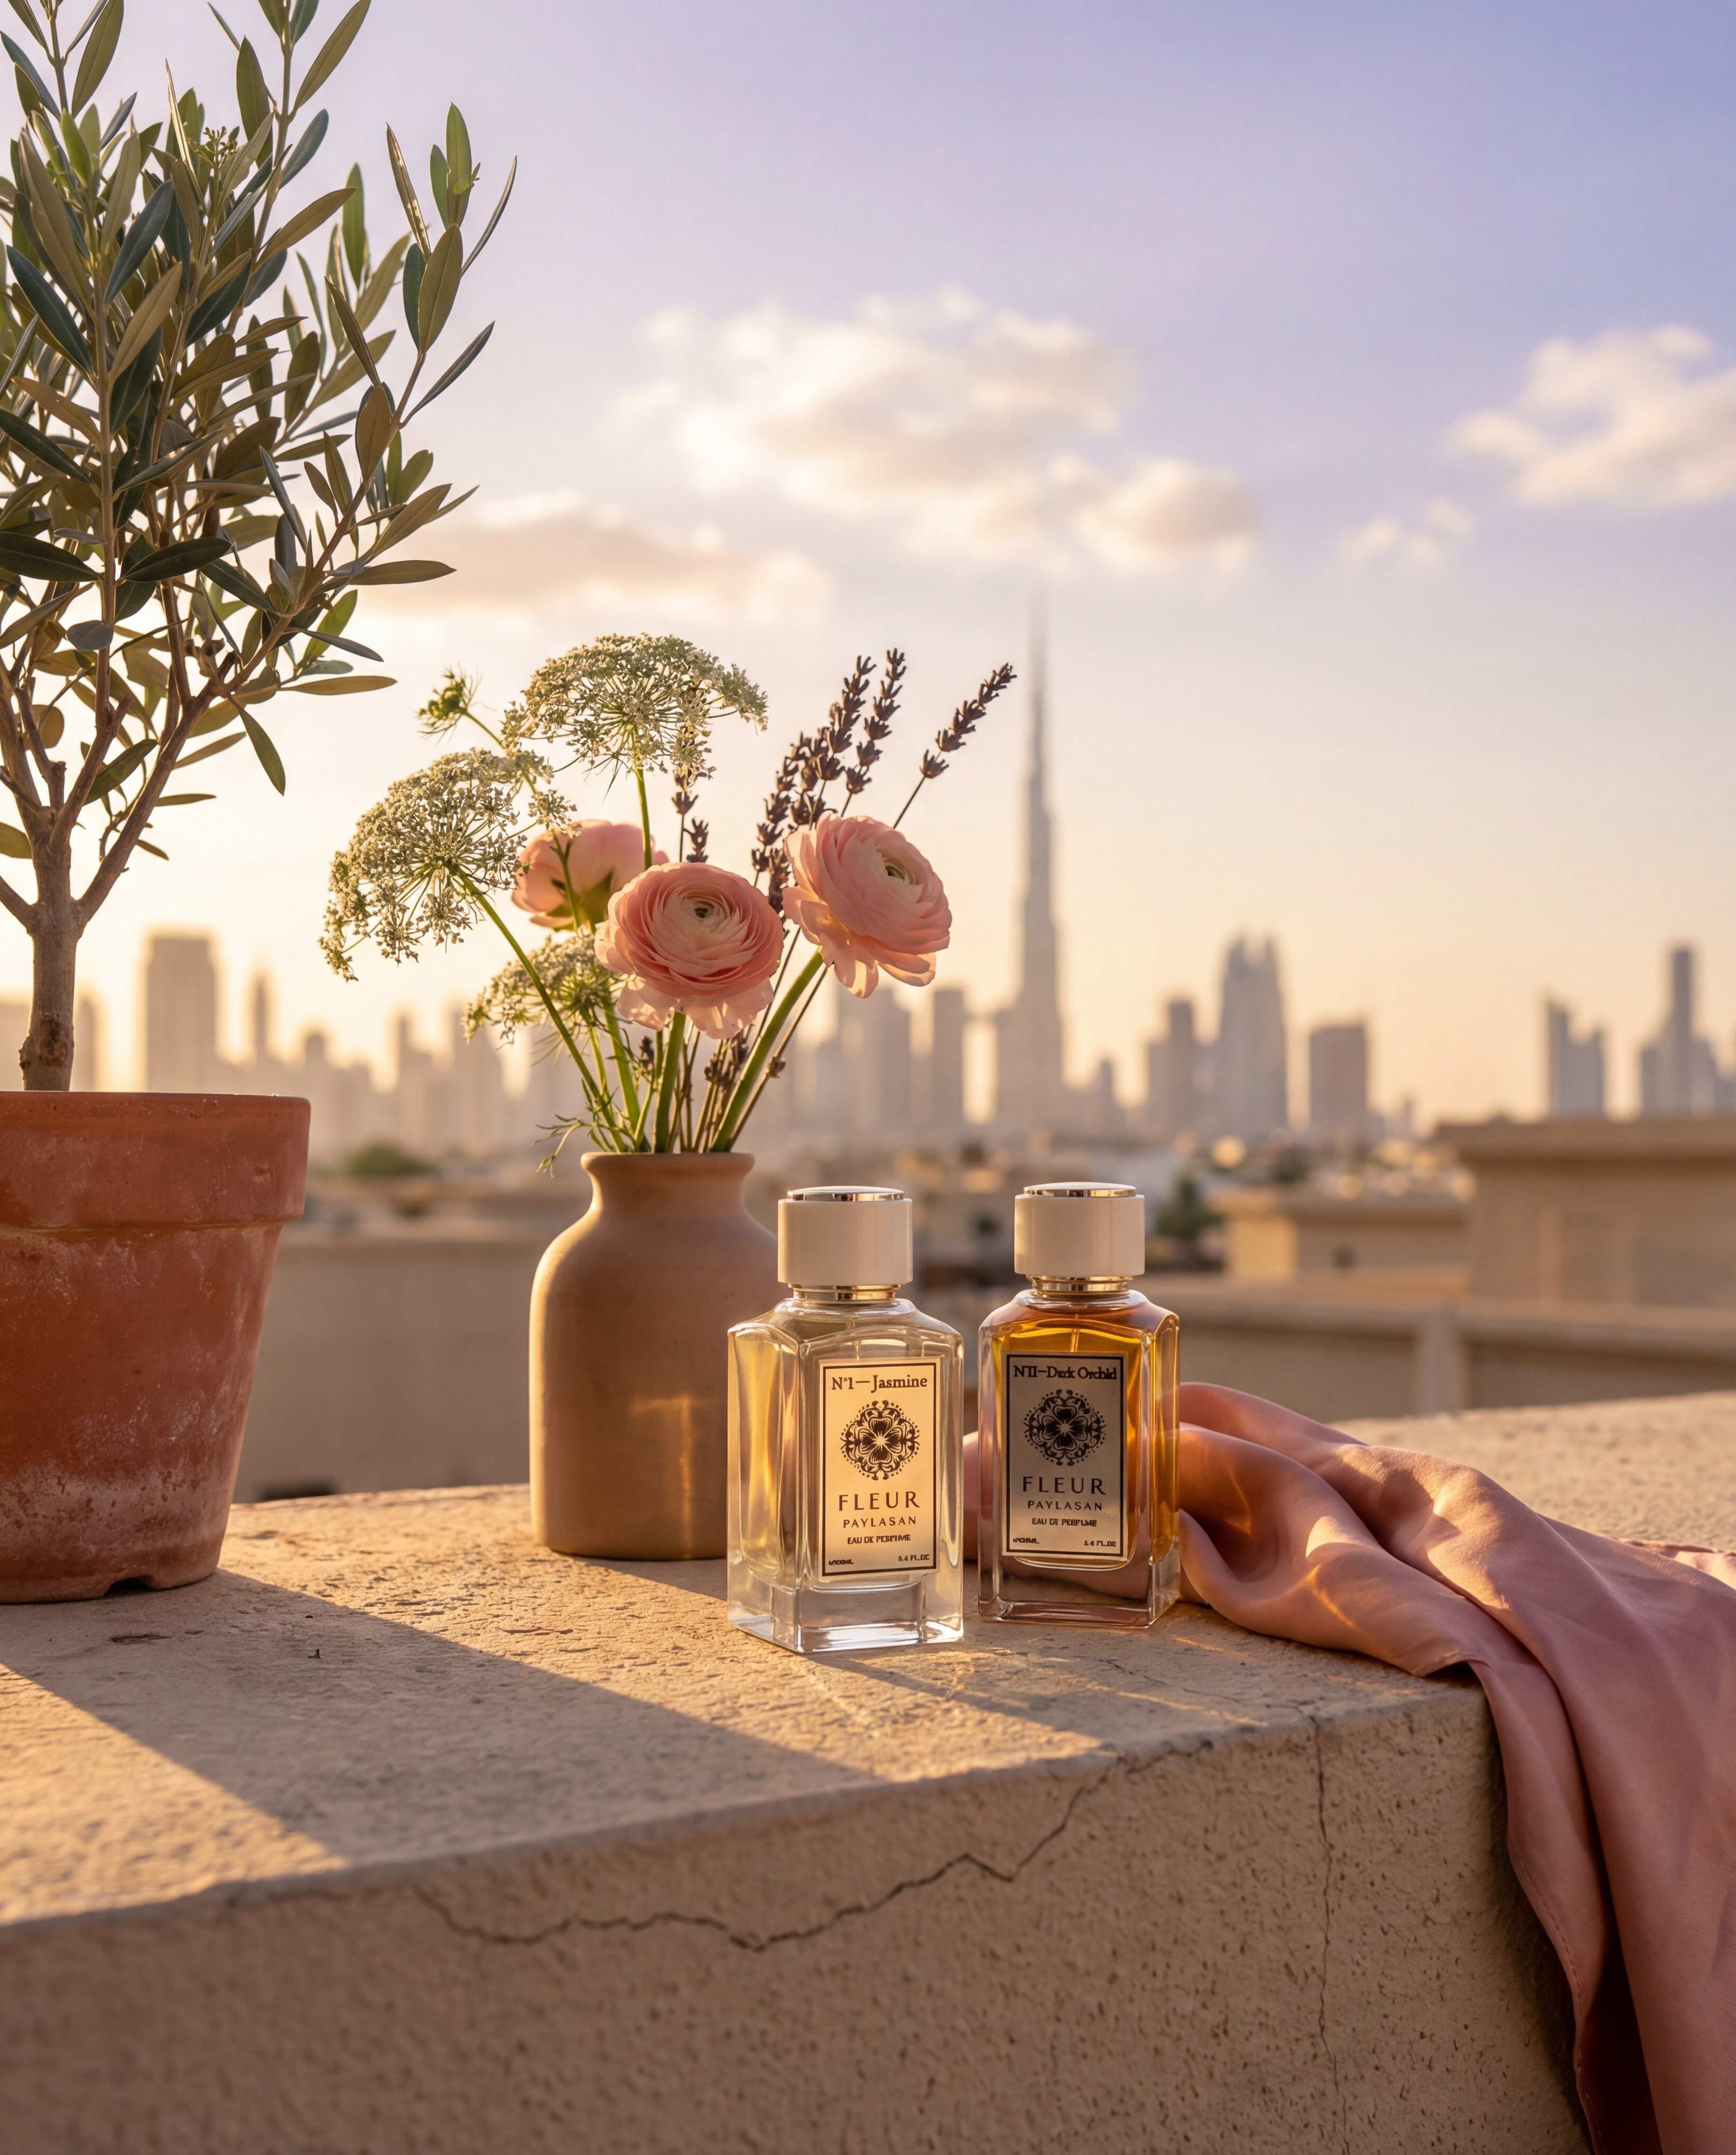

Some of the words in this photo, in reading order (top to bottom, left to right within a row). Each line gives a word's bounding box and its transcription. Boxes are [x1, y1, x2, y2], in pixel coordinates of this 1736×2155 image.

[1077, 1367, 1117, 1380] Orchid
[1023, 1476, 1106, 1495] FLEUR
[839, 1491, 920, 1511] FLEUR
[1027, 1500, 1102, 1511] PAYLASAN
[843, 1516, 916, 1528] PAYLASAN
